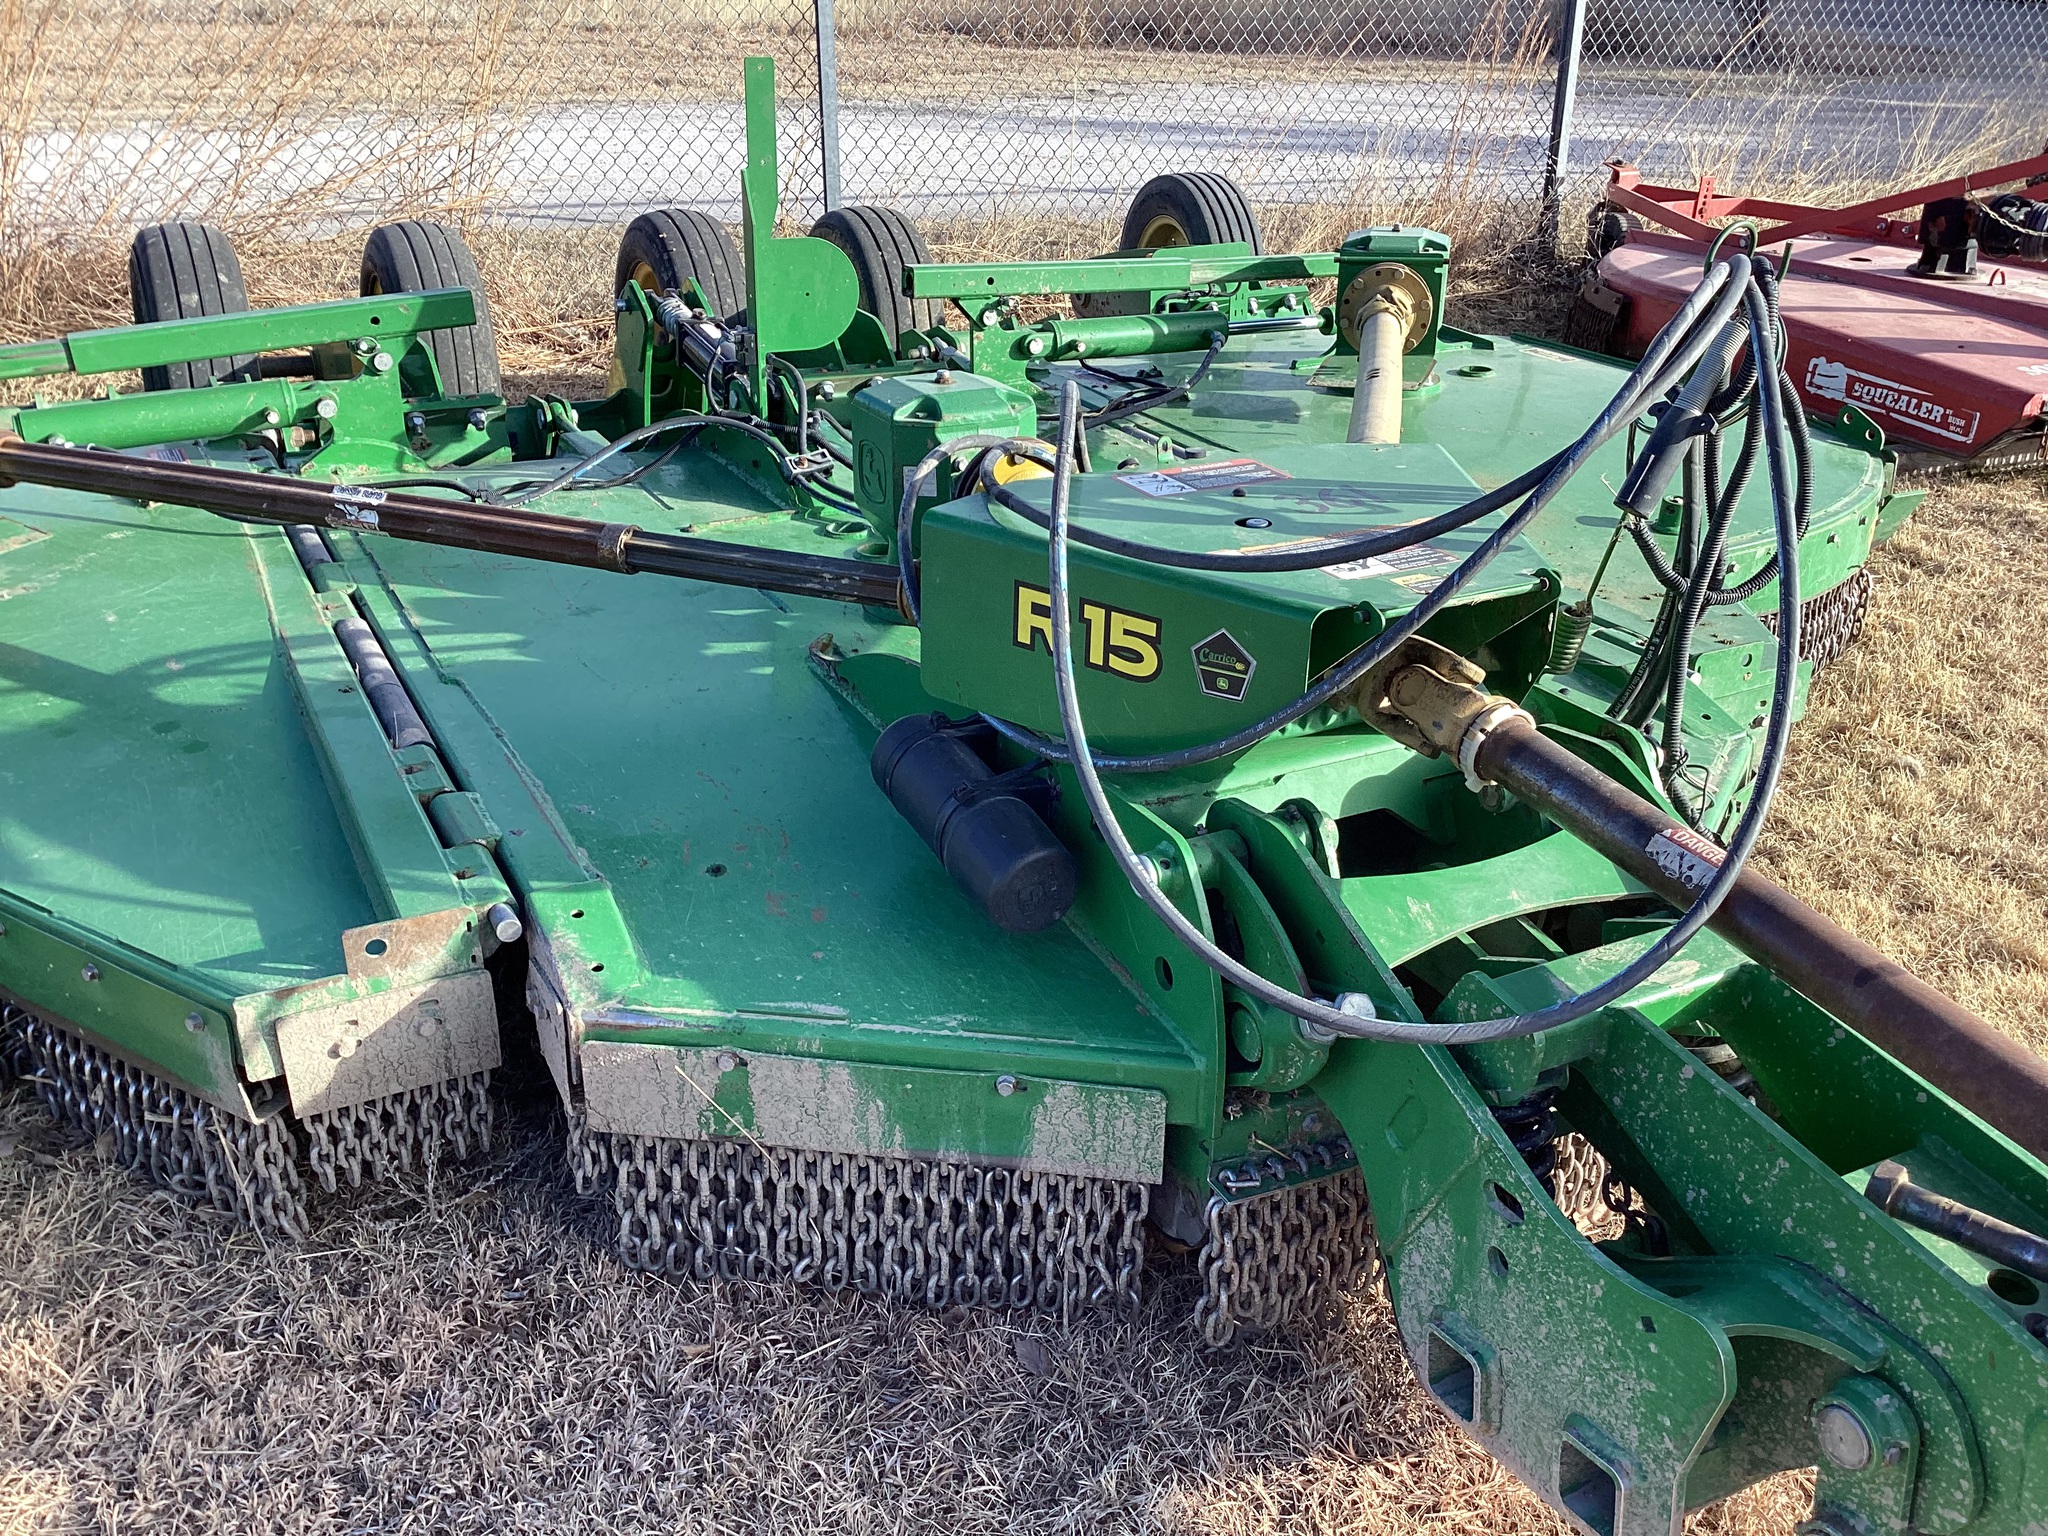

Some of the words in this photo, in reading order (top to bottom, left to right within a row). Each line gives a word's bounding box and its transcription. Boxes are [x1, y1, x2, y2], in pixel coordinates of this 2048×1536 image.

[1852, 382, 1944, 423] SQUEALER
[1947, 416, 1966, 427] BUSH
[1199, 648, 1237, 664] Carrico
[1672, 830, 1728, 868] DANGE
